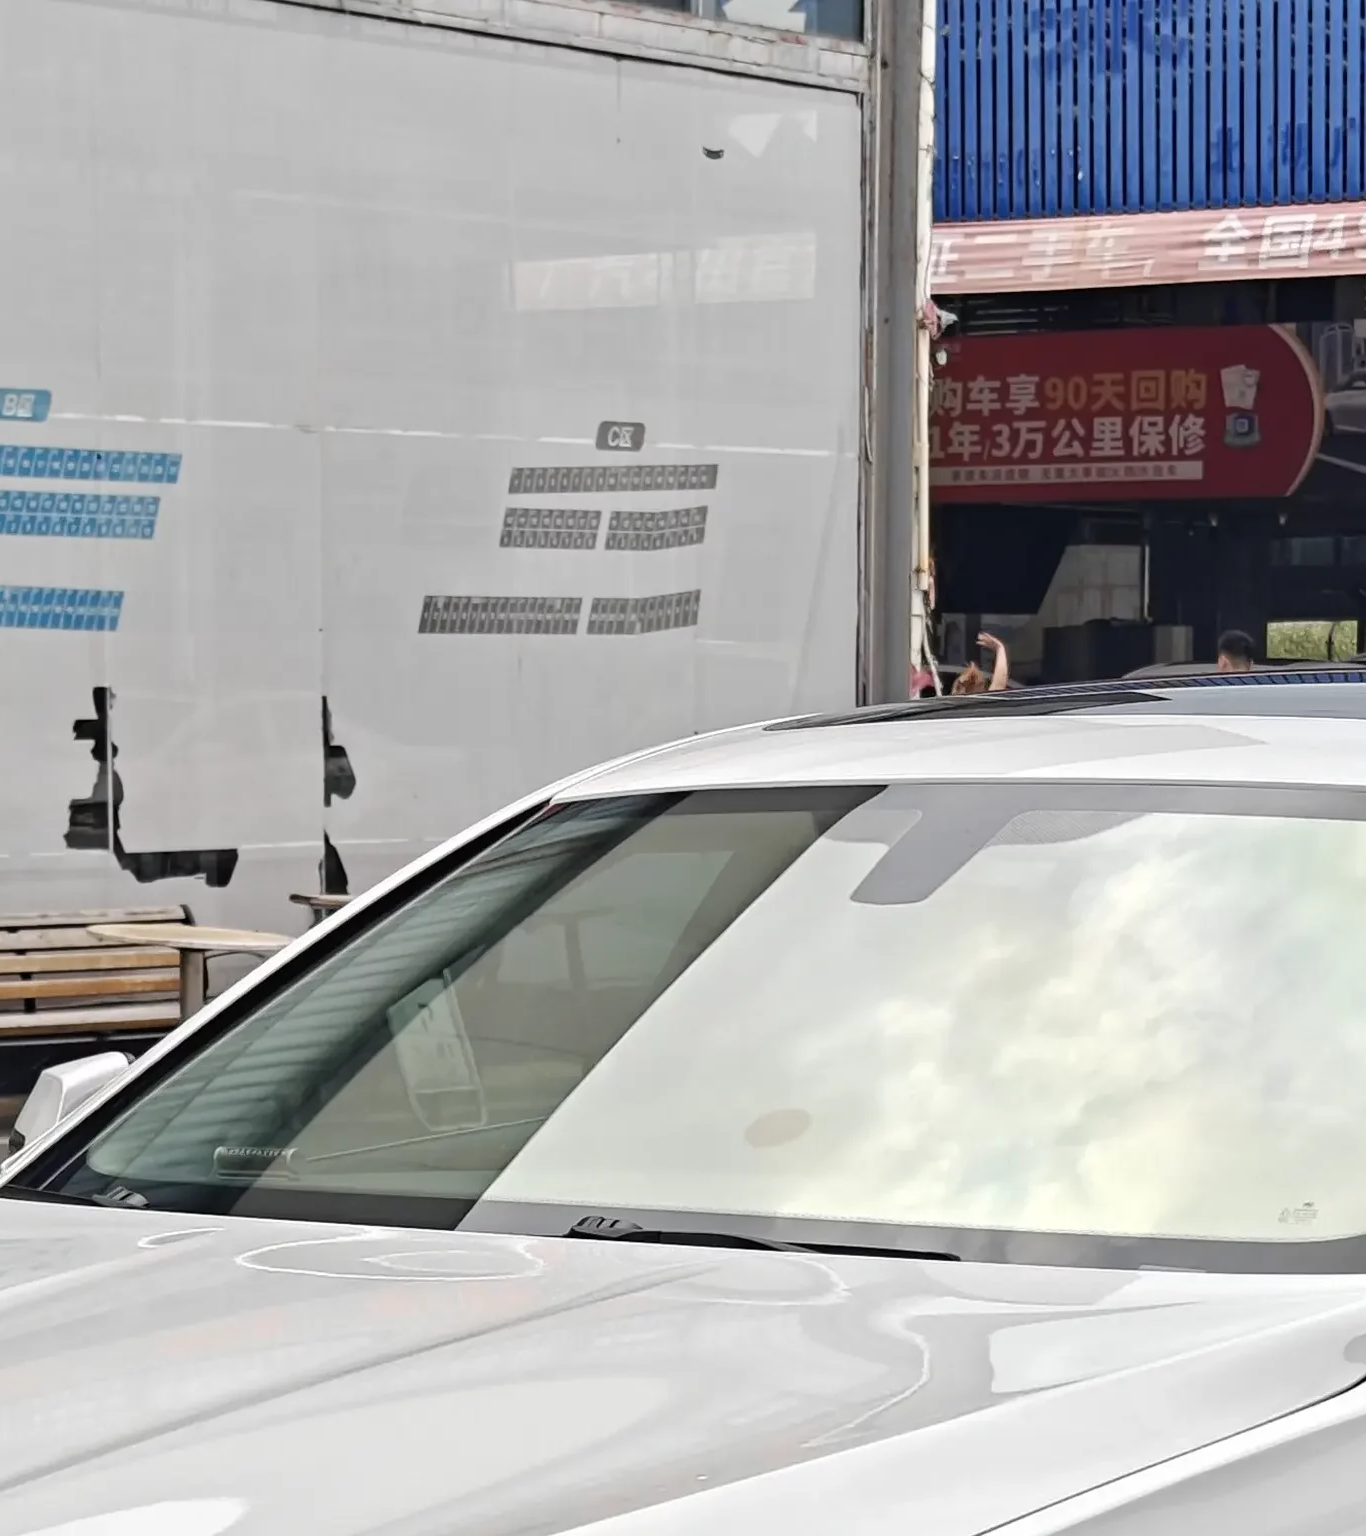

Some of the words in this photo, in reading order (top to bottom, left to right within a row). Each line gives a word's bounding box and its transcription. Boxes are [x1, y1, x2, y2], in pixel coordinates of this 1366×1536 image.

[932, 368, 1208, 418] 购车享90天回购
